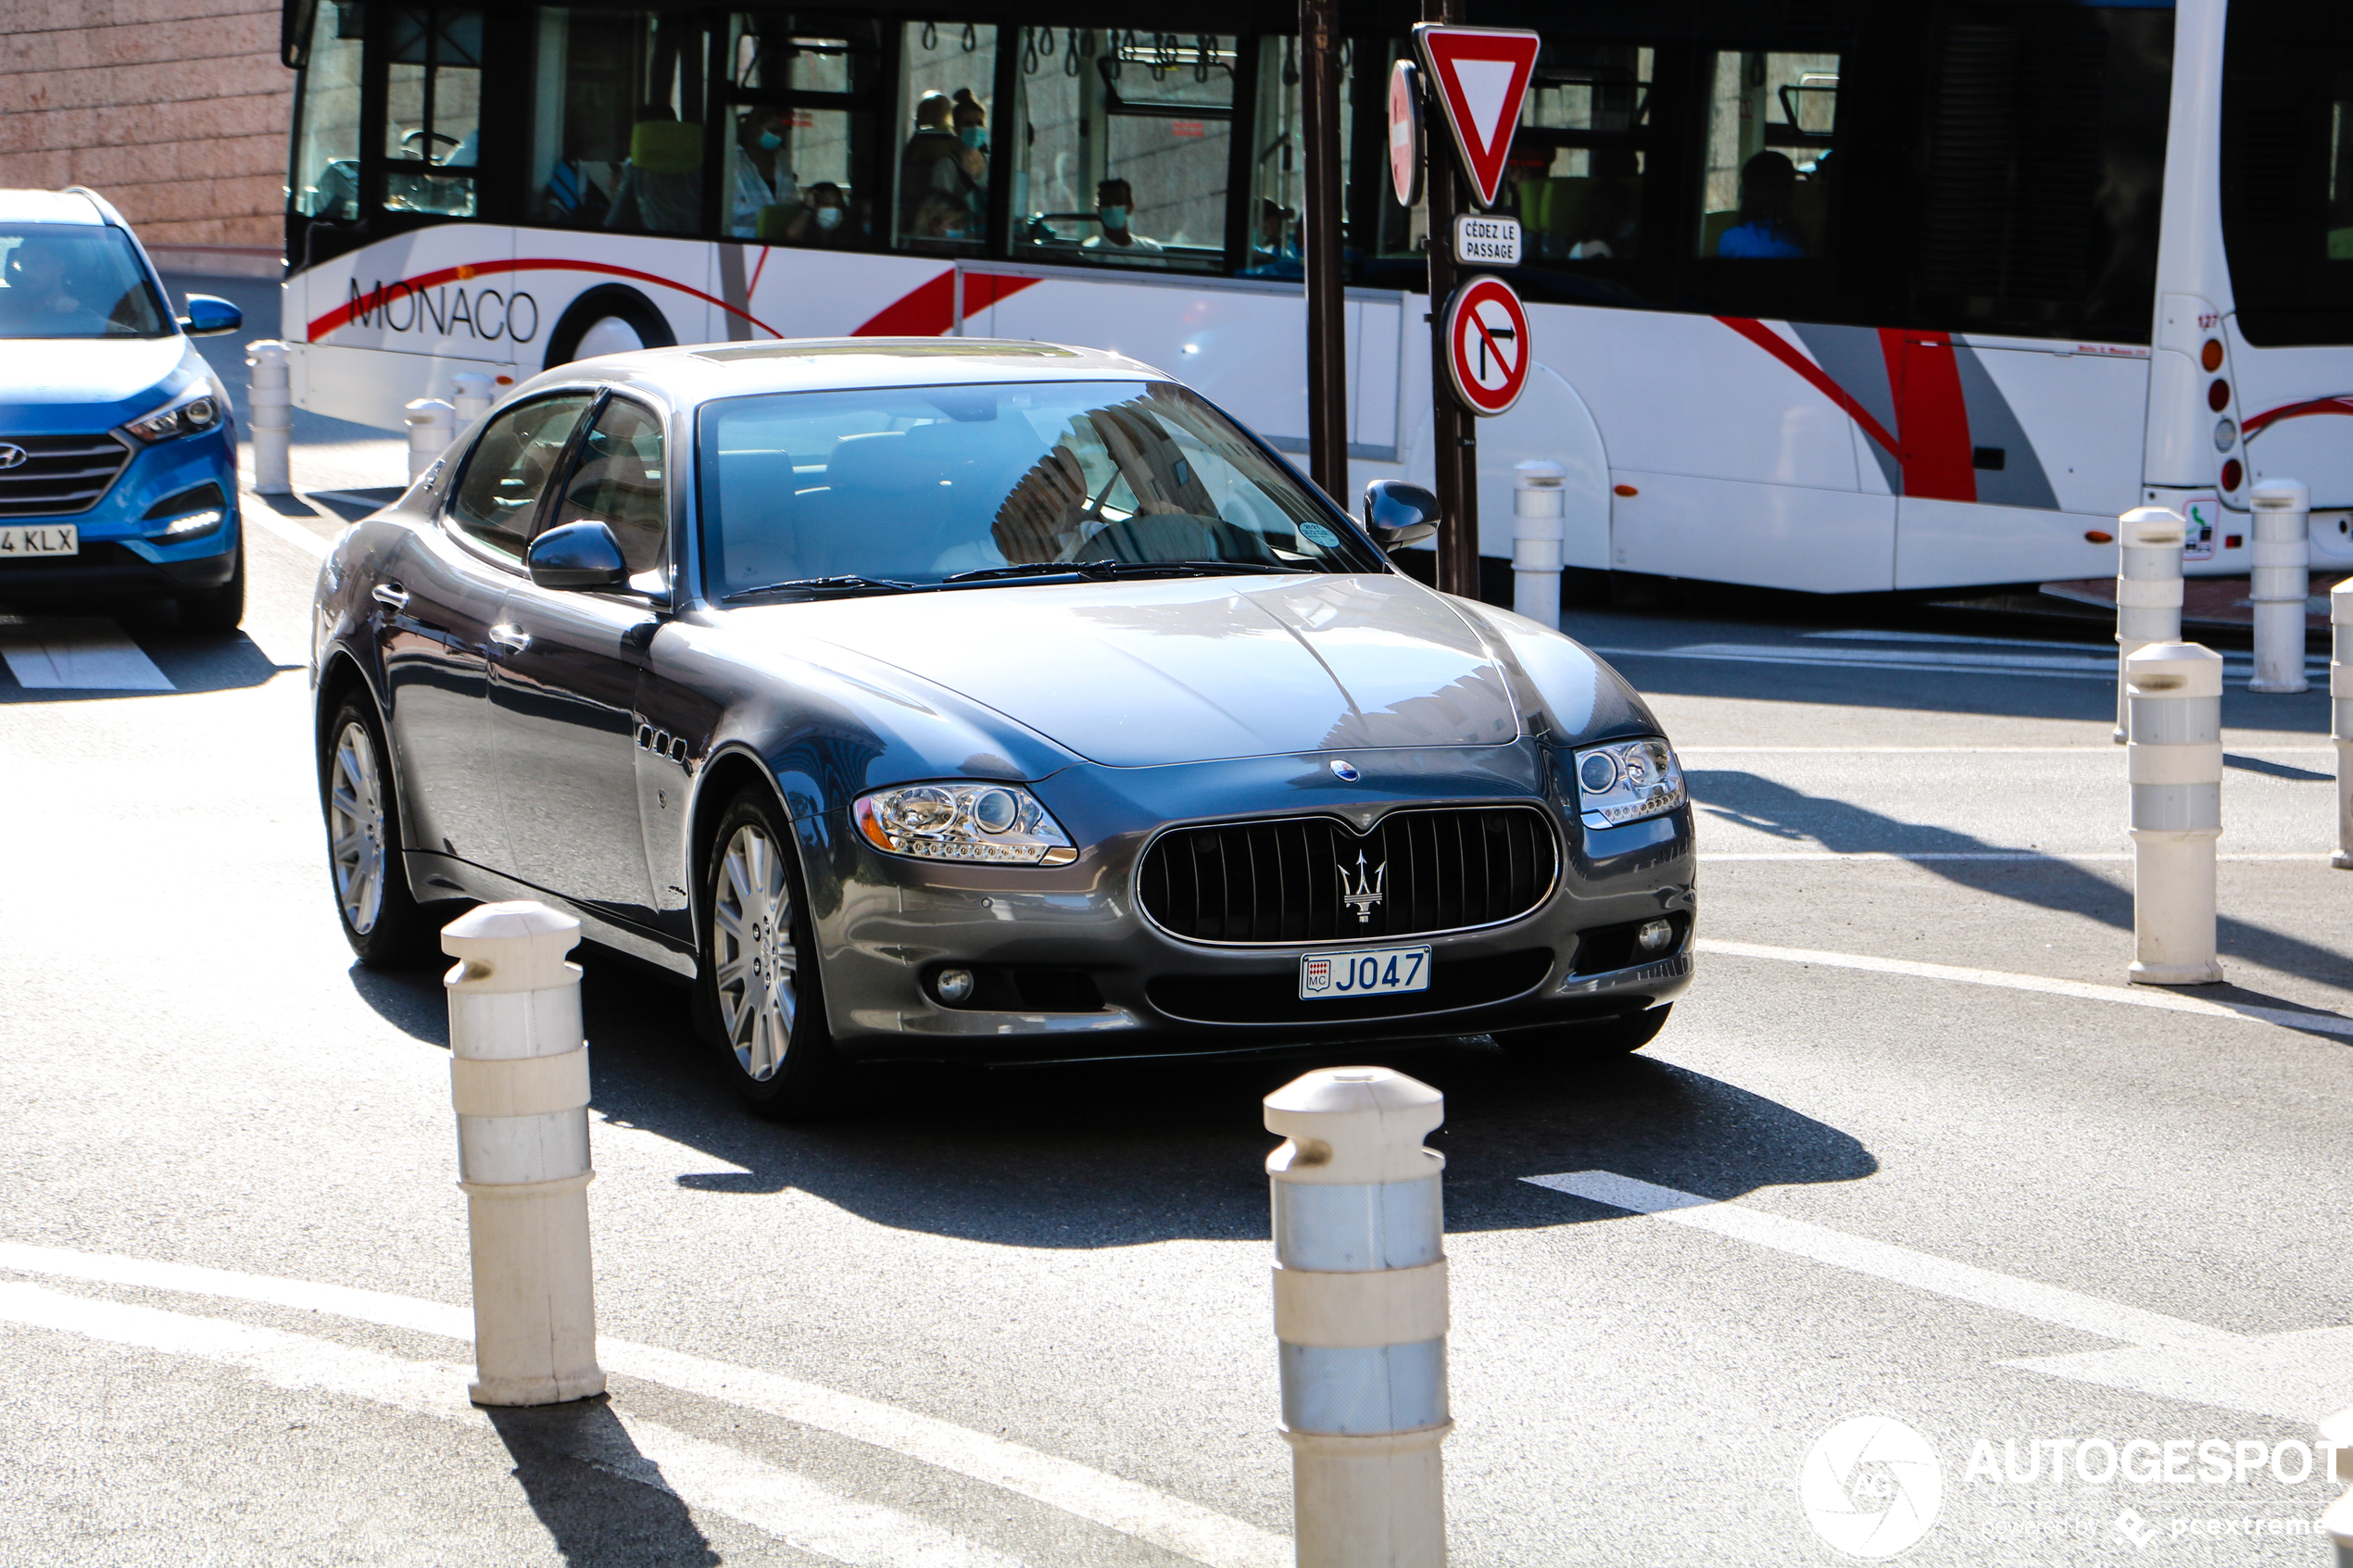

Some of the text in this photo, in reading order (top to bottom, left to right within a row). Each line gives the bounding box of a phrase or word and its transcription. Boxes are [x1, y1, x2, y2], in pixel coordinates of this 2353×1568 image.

[1466, 220, 1515, 240] CÉDEZ LE
[1466, 243, 1514, 259] PASSAGE
[349, 277, 539, 344] MONACO
[24, 529, 73, 552] KLX
[1309, 975, 1327, 985] MC
[1335, 952, 1425, 991] J047
